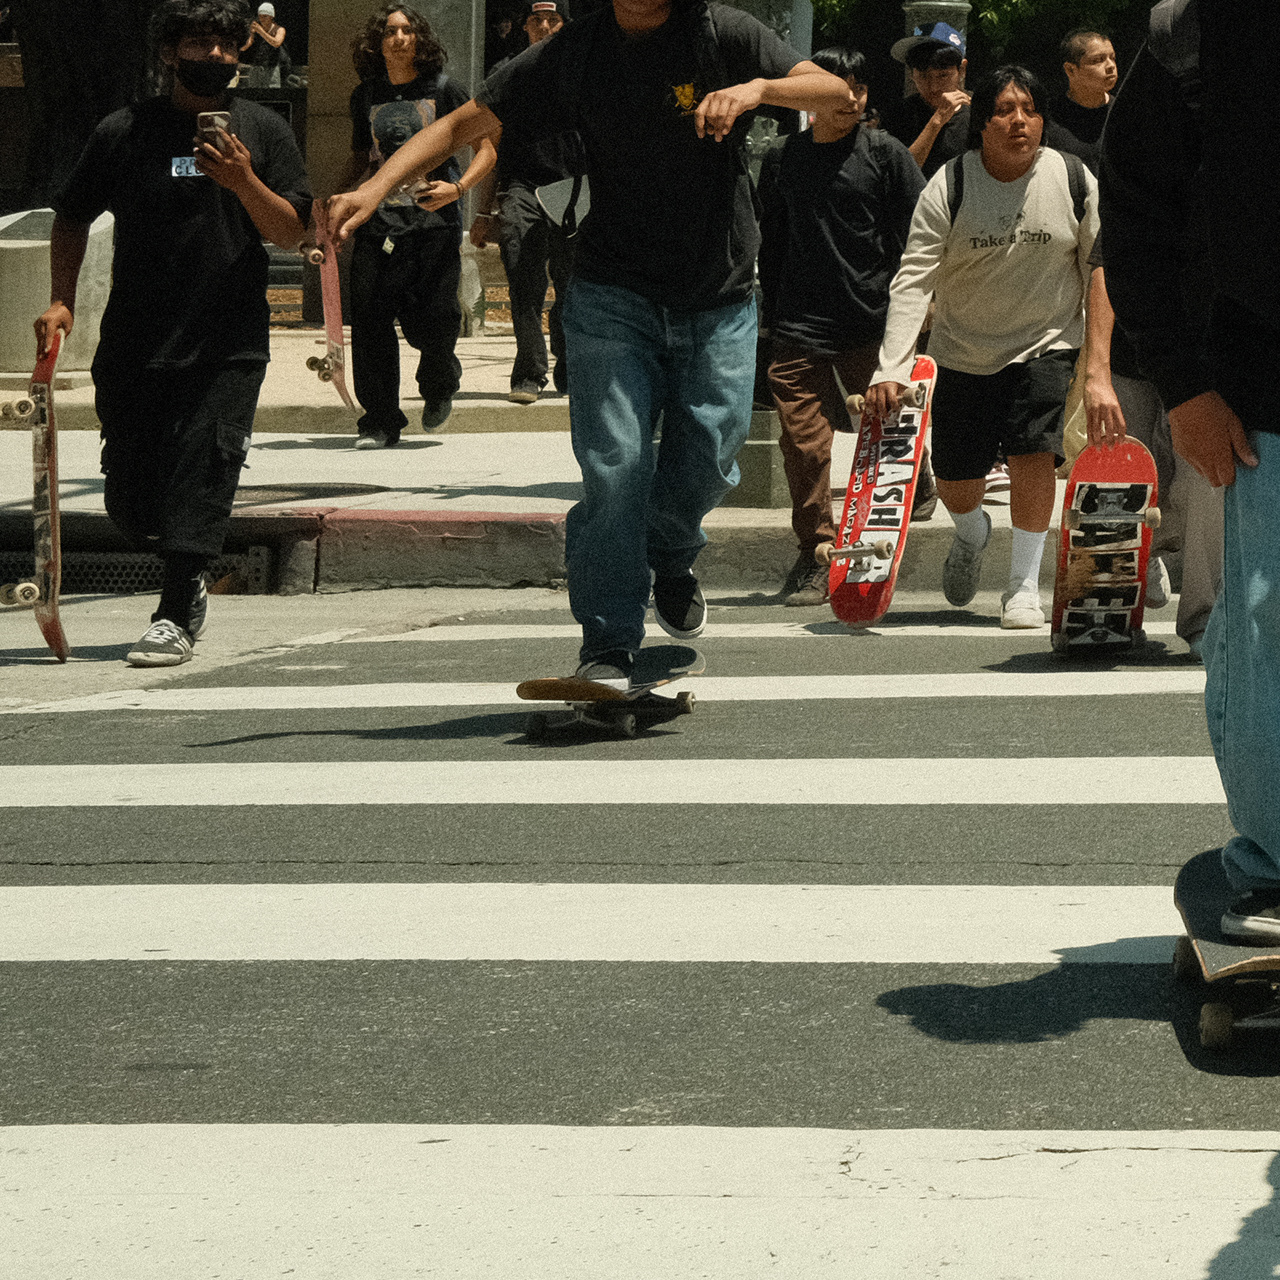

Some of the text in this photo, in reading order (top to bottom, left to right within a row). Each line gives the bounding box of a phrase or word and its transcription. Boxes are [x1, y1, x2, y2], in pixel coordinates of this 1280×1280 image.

[969, 234, 1005, 250] Take
[1020, 228, 1052, 245] Trip
[835, 497, 859, 568] MAGAZIE
